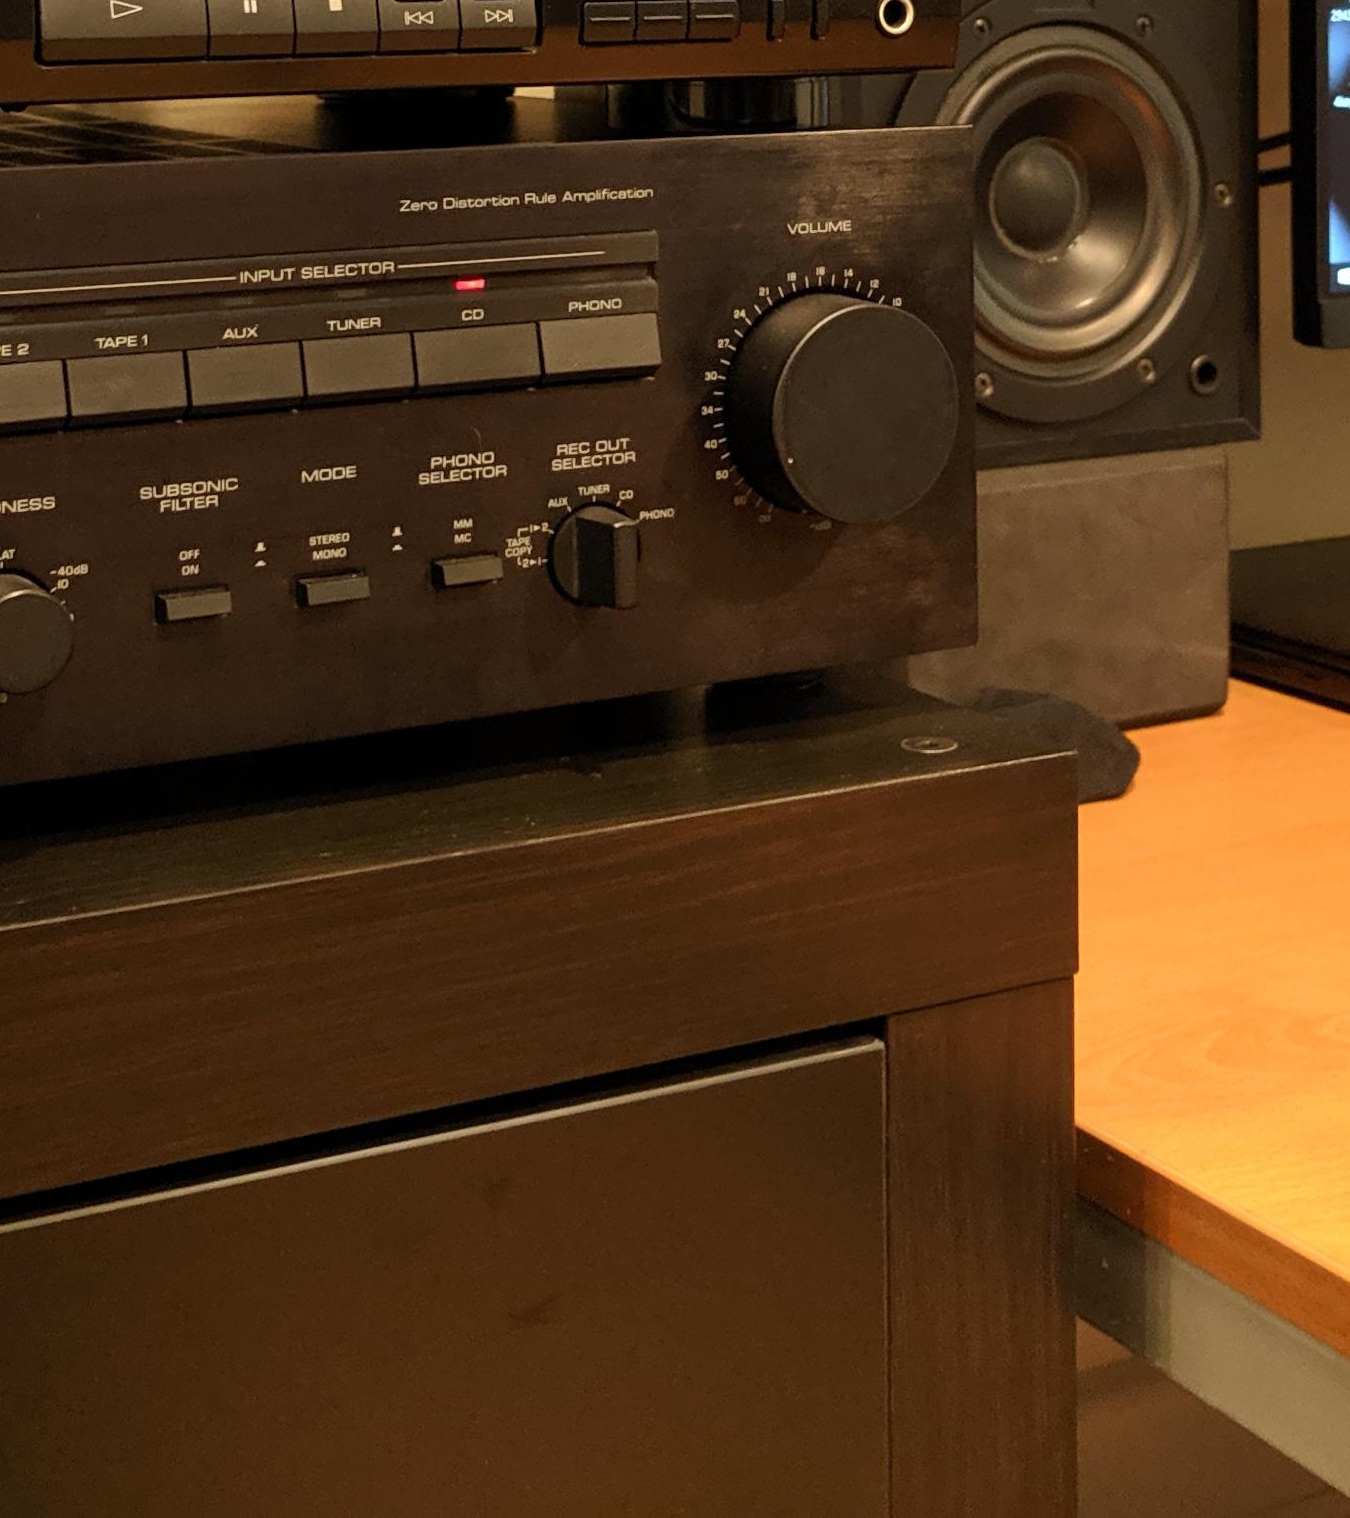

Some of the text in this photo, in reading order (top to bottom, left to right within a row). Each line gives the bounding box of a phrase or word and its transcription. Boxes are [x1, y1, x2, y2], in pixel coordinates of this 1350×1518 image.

[399, 186, 654, 213] Zero Distortion Rule Amplification
[787, 220, 852, 235] VOLUME
[239, 261, 395, 285] INPUT SELECTOR
[568, 297, 623, 312] PHONO
[461, 308, 484, 321] CD
[327, 316, 382, 332] TUNER
[222, 324, 259, 340] AUX
[16, 343, 30, 356] 2
[95, 336, 137, 350] TAPE
[556, 438, 631, 457] REC OUT
[430, 450, 496, 470] PHONO
[551, 450, 636, 472] SELECTOR
[301, 465, 357, 483] MODE
[418, 464, 507, 485] SELECTOR
[139, 478, 239, 500] SUBSONIC
[578, 484, 610, 496] TUNER
[619, 490, 633, 500] CD
[160, 494, 219, 513] FILTER
[548, 497, 568, 508] AUX
[639, 508, 675, 520] PHONO
[453, 518, 473, 529] MM
[309, 532, 350, 546] STEREO
[454, 533, 472, 544] MC
[505, 536, 531, 548] TAPE
[179, 549, 200, 562] OFF
[312, 547, 347, 560] MONO
[505, 545, 532, 558] COPY
[182, 563, 199, 576] ON
